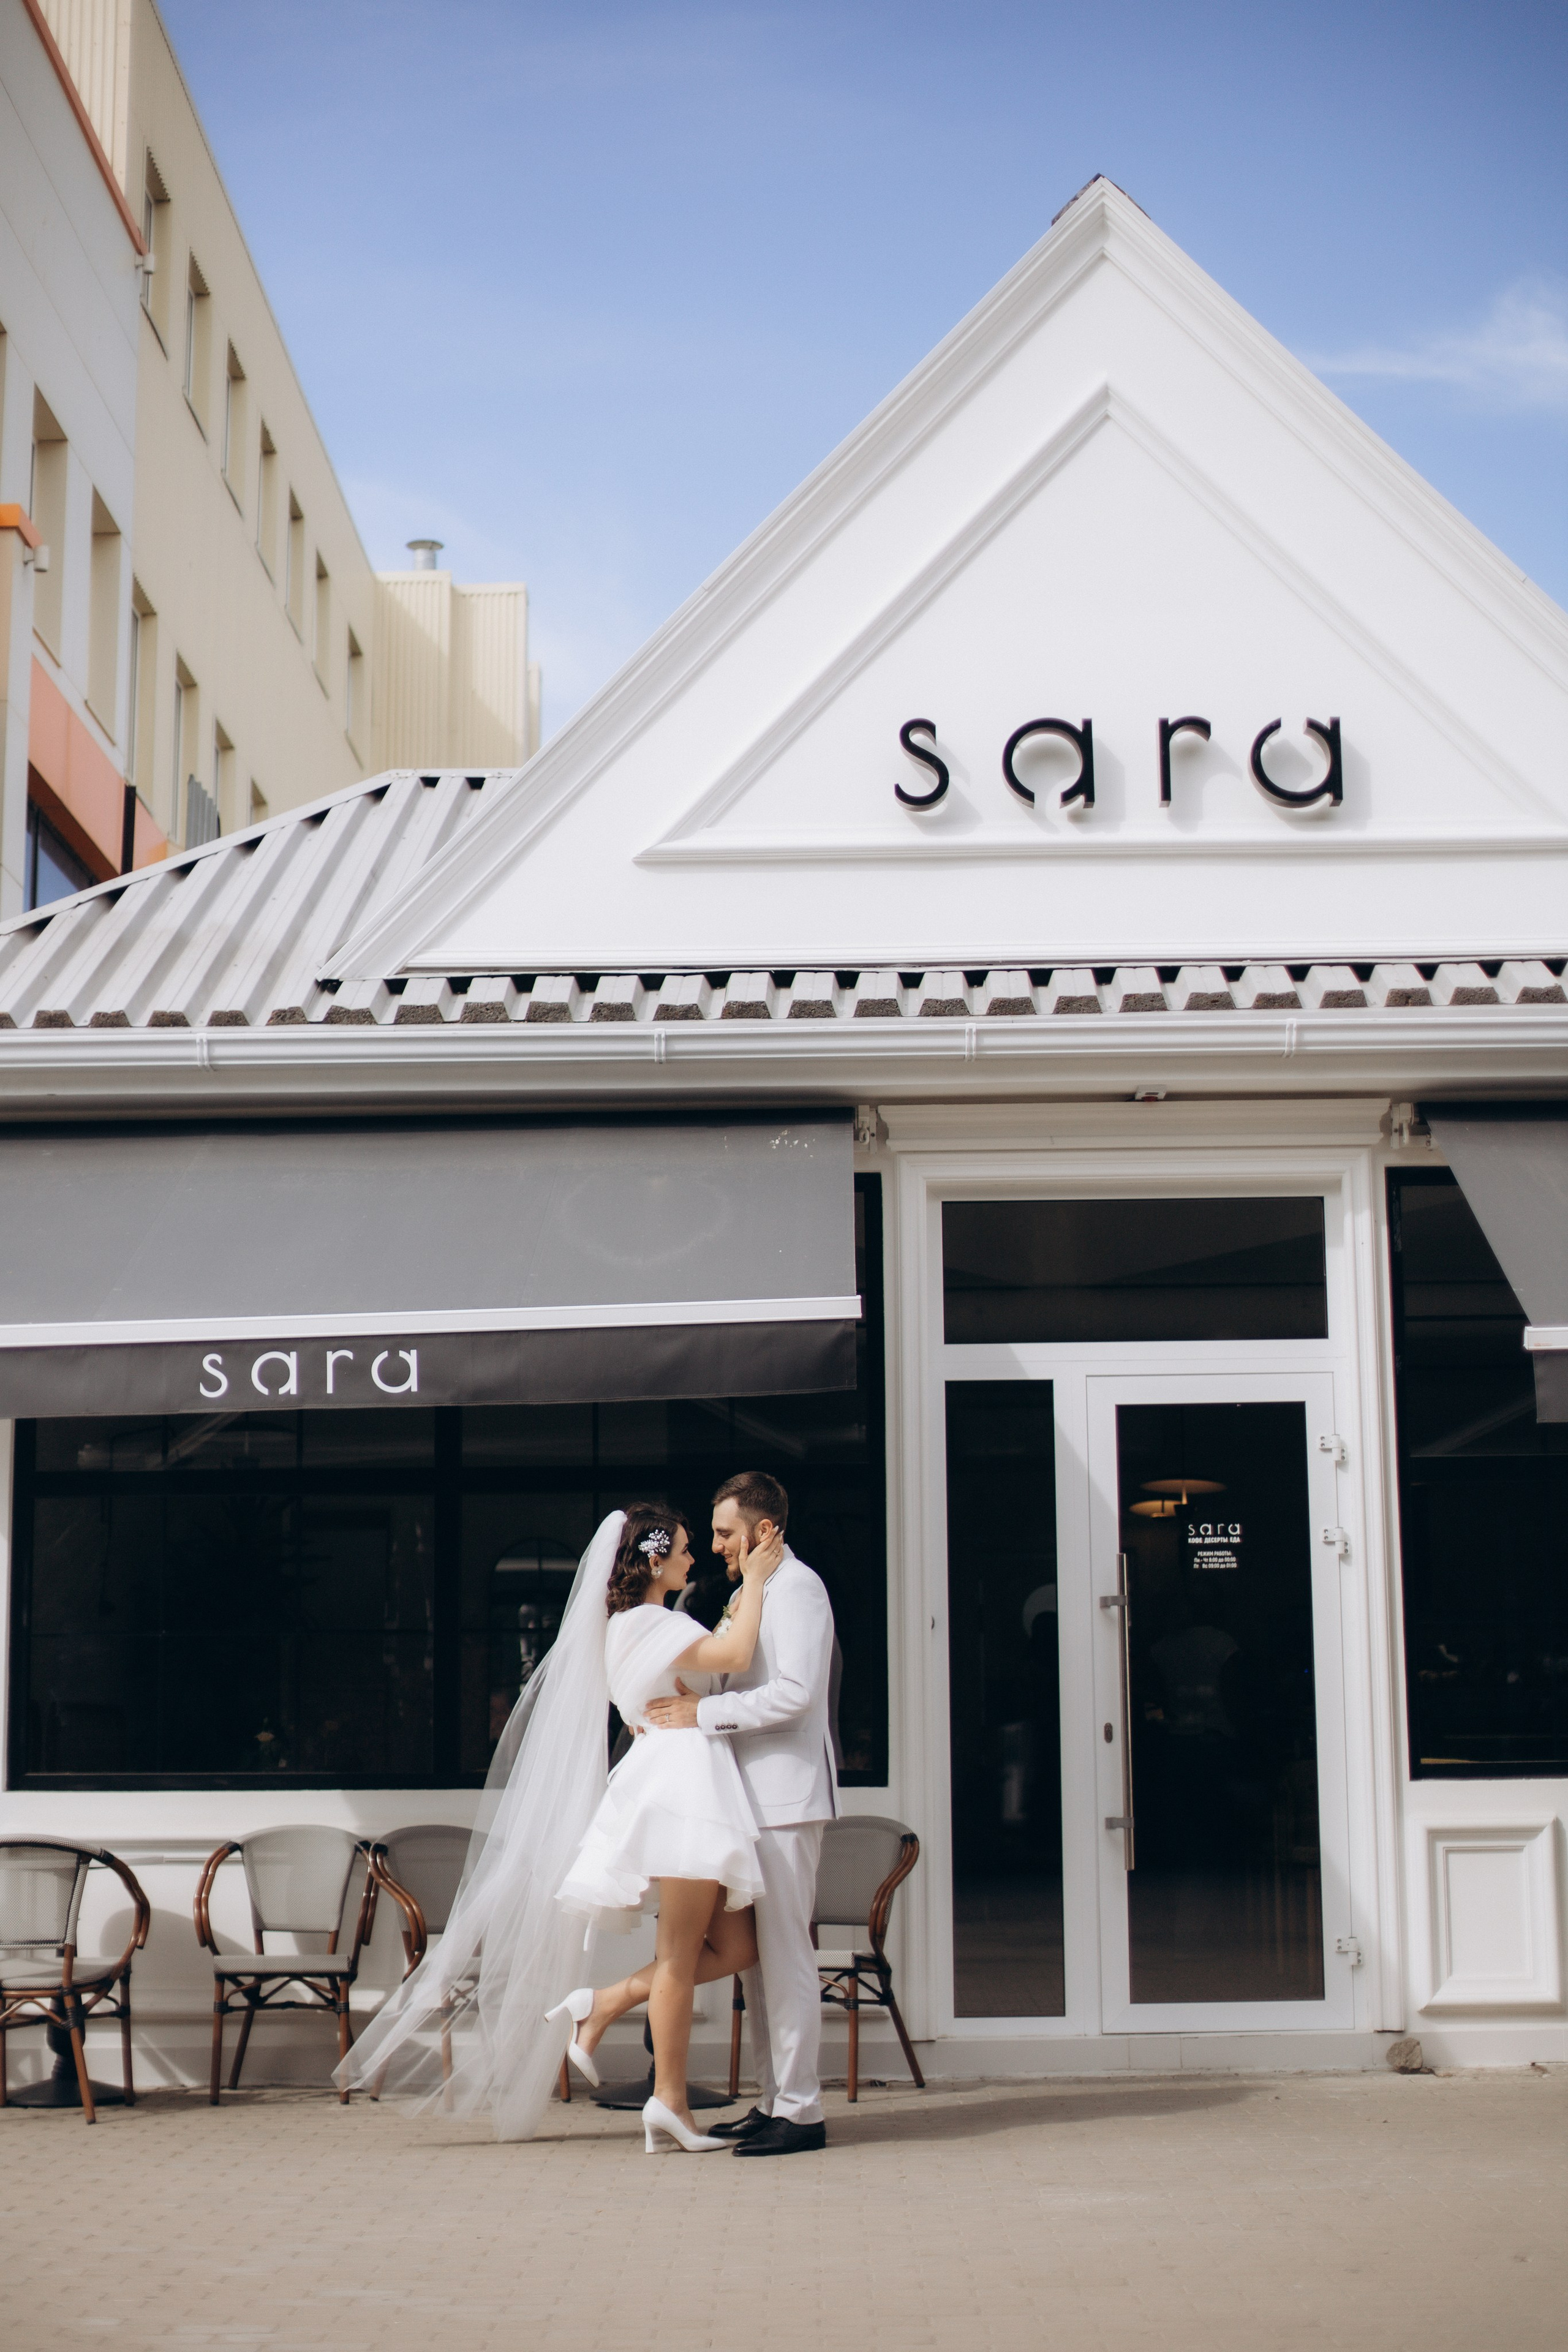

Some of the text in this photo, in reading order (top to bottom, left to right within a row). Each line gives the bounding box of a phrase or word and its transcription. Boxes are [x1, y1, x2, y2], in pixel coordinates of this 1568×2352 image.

[894, 716, 1343, 812] sara
[200, 1349, 418, 1398] sara
[1188, 1523, 1240, 1536] sara
